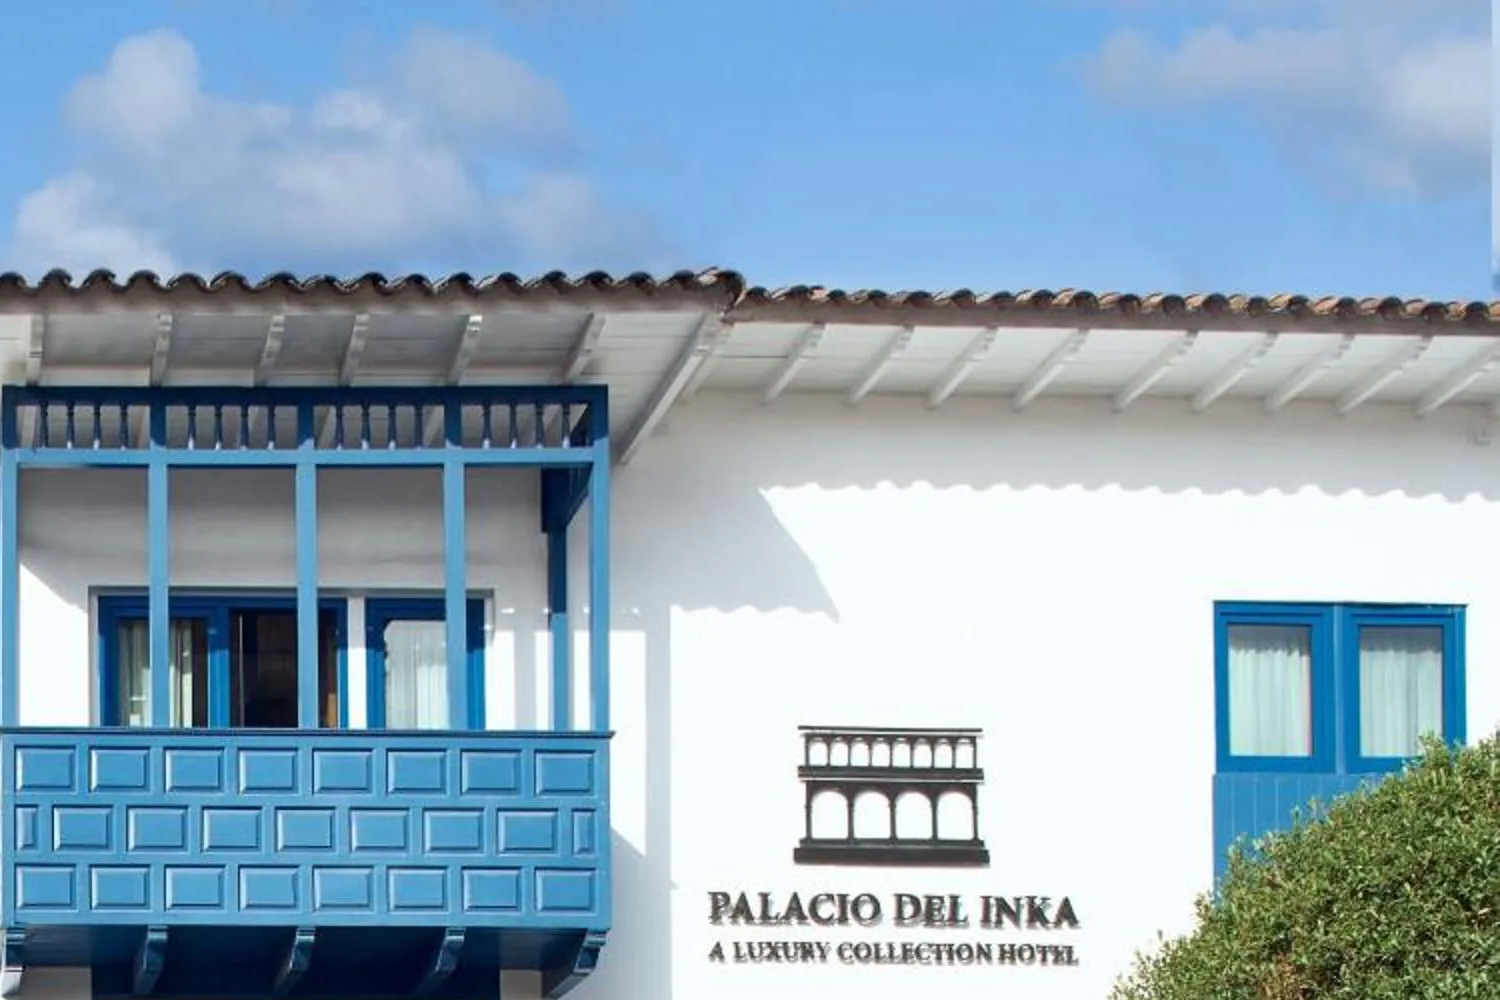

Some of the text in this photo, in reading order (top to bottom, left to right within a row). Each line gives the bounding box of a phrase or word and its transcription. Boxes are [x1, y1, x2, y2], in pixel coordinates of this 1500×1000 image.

[707, 891, 1080, 929] PALACIO DEL INKA
[708, 941, 1079, 966] A LUXURY COLLECTION HOTEL
